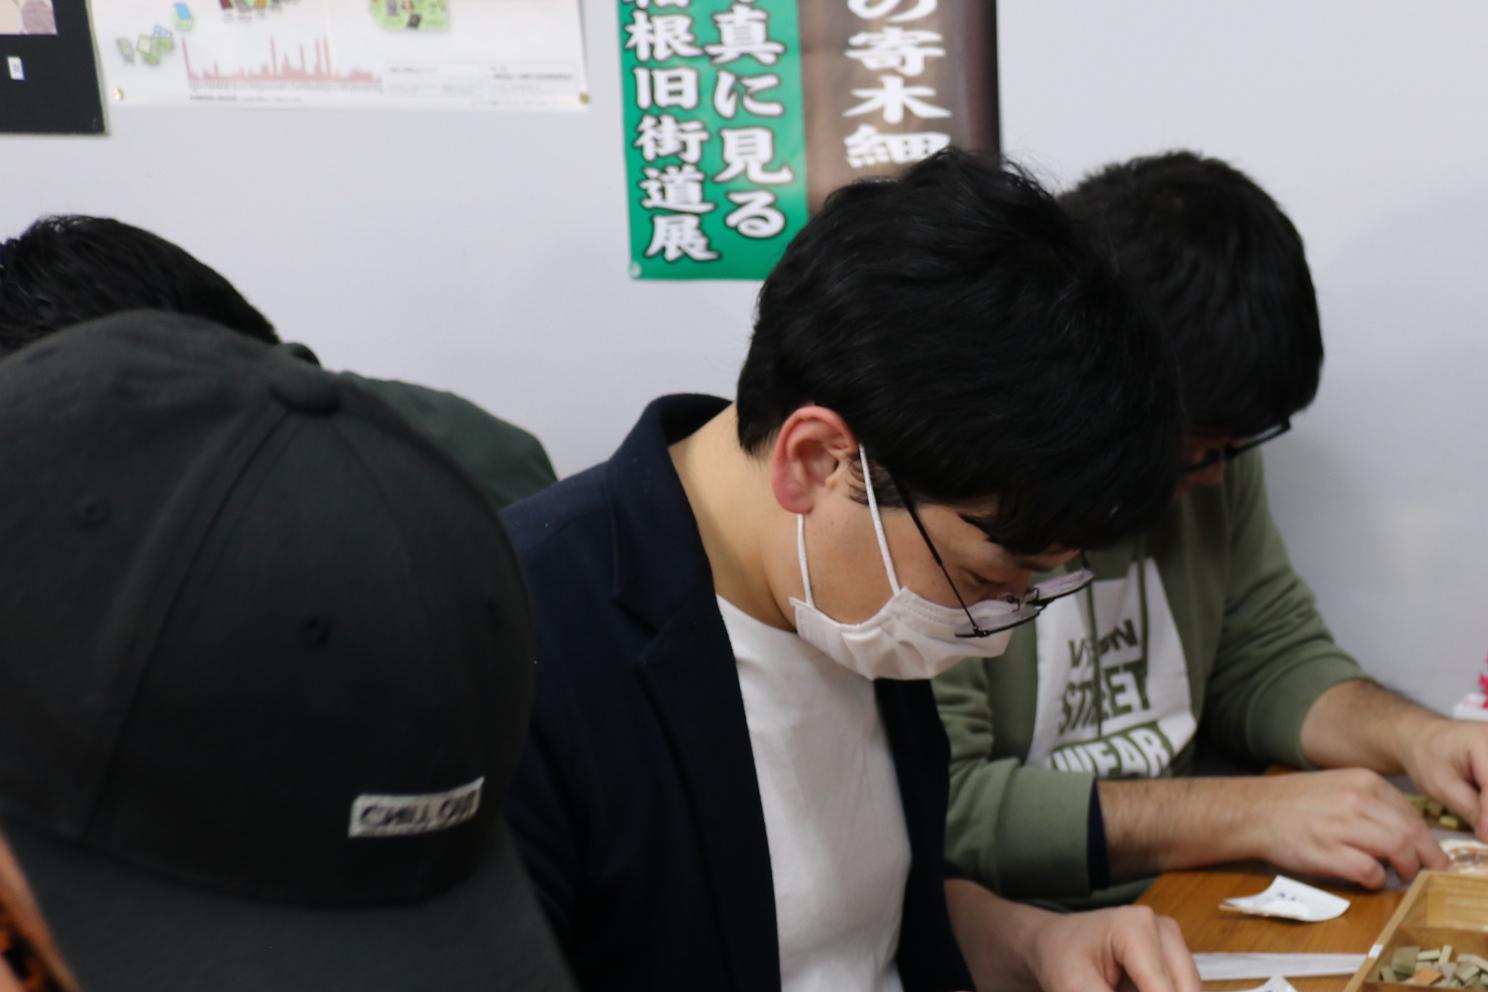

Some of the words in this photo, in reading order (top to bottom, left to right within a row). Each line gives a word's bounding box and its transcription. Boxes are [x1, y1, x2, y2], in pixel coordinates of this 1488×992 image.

[624, 0, 720, 262] 根旧街道展
[703, 0, 793, 239] 真に見る
